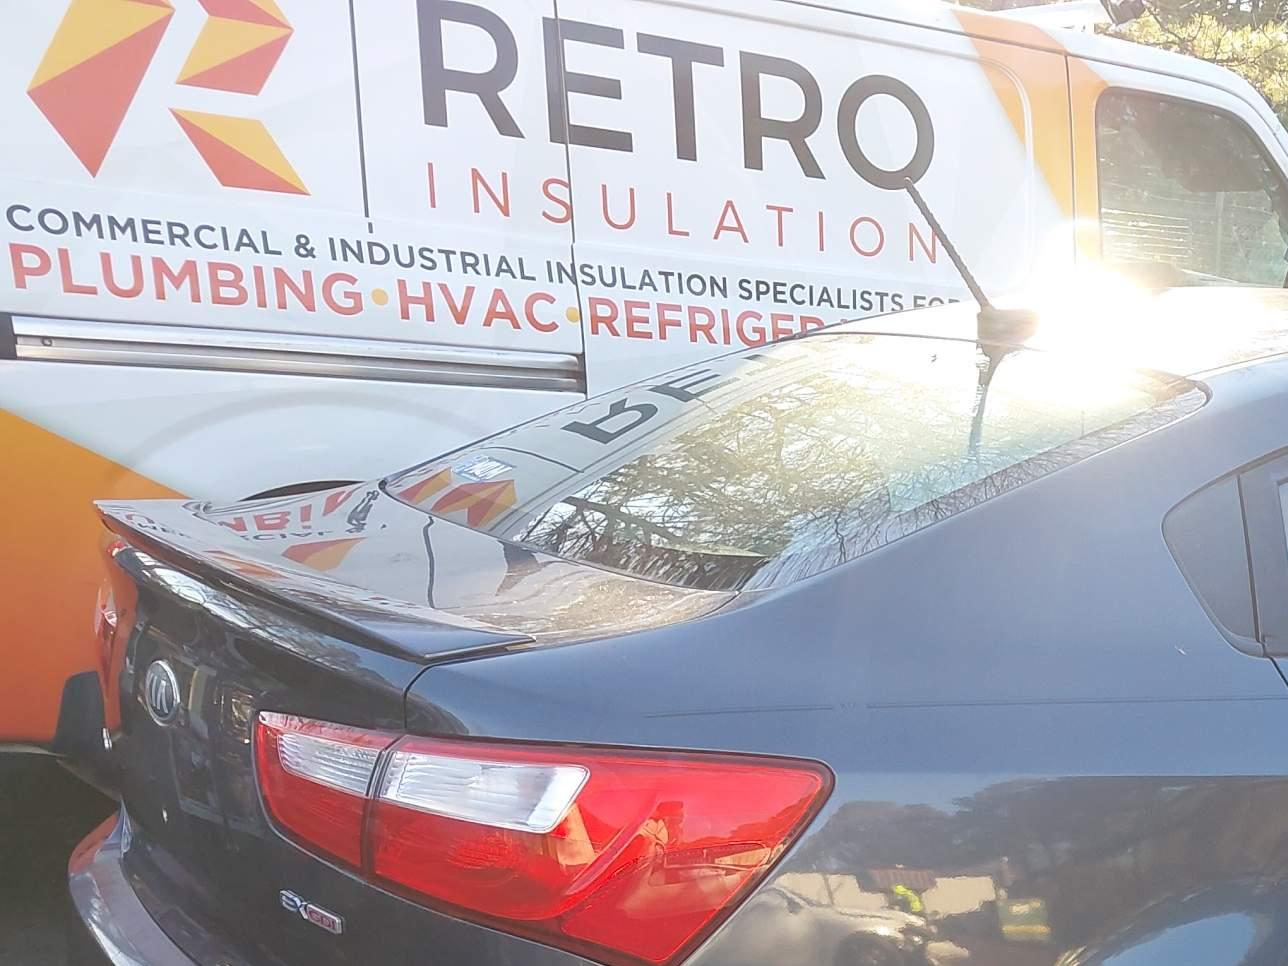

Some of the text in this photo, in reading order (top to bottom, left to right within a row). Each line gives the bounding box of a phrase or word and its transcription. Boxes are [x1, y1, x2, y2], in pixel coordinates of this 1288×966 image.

[417, 0, 934, 190] RETRO
[6, 204, 904, 312] COMMERCIAL & INDUSTRIAL INSULATION SPECIALISTS
[427, 162, 941, 262] INSULATION
[9, 242, 364, 316] PLUMBING
[397, 279, 558, 333] HVAC
